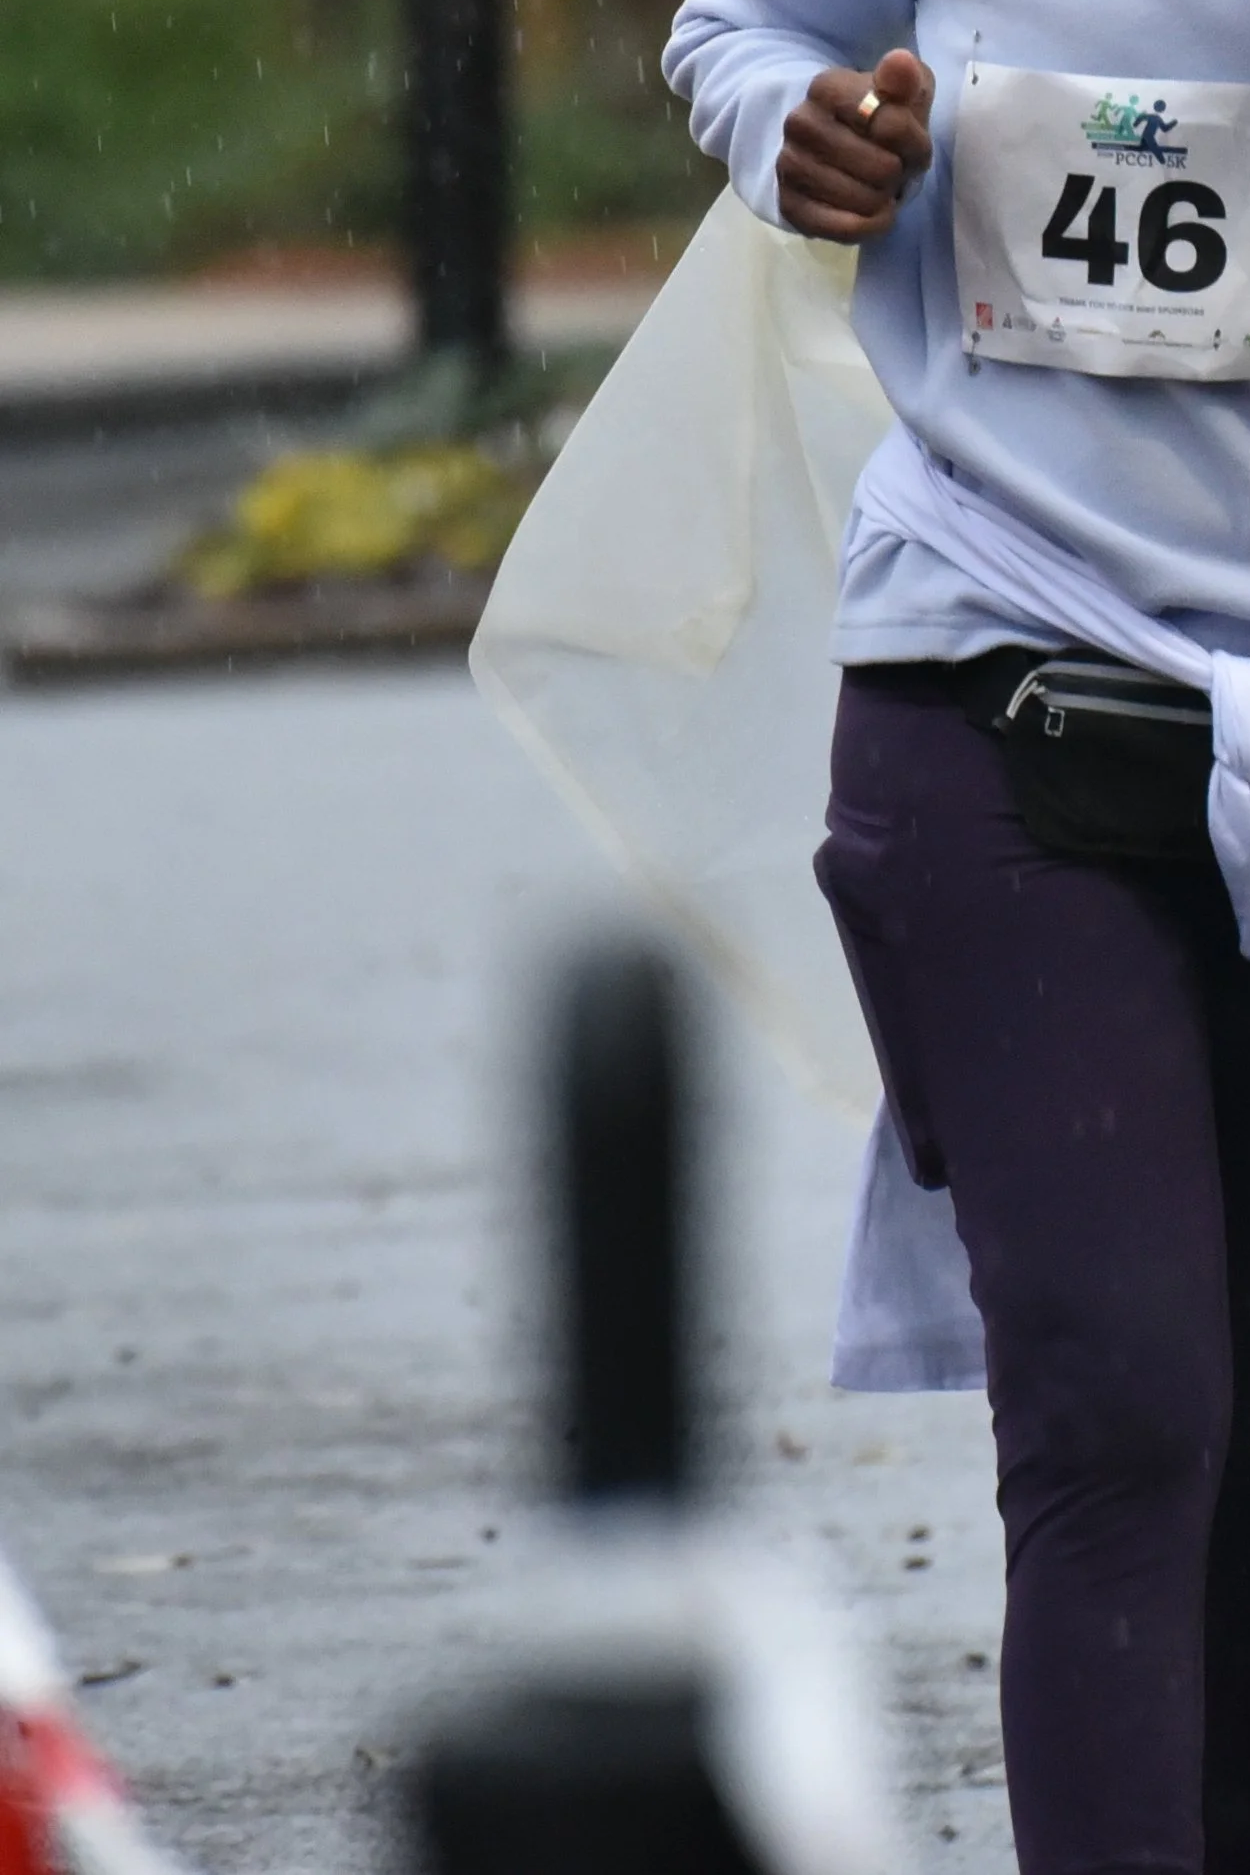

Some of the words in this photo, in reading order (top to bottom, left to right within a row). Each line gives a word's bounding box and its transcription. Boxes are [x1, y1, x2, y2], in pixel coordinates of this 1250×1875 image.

[1115, 152, 1153, 167] PCCI
[1166, 153, 1187, 169] 5K
[1042, 174, 1227, 293] 46
